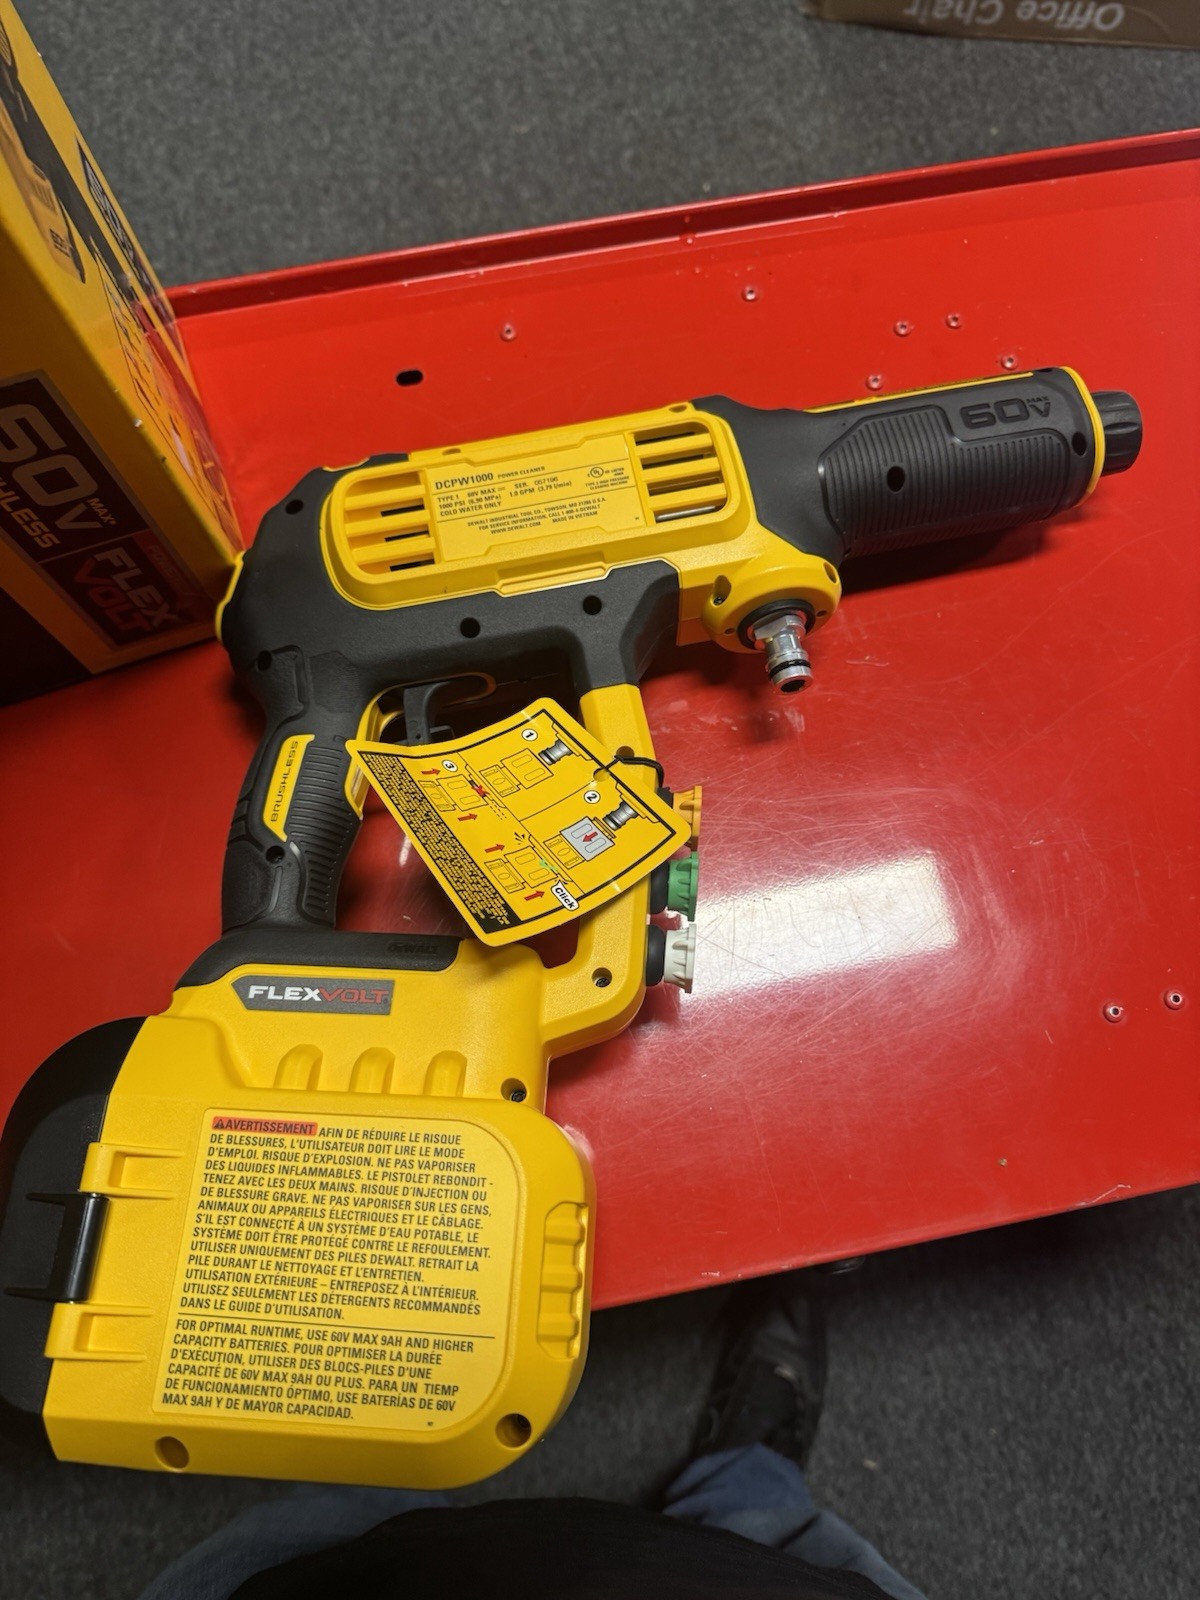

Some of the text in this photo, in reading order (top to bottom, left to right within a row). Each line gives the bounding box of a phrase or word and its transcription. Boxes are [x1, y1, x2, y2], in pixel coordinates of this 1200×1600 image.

[903, 0, 1125, 32] Office Chair
[1027, 395, 1049, 404] MAX
[435, 466, 545, 490] DCPW1000 POWER CLEANER
[519, 487, 535, 496] GPM
[440, 501, 501, 517] COLD WATER ONLY
[490, 513, 519, 523] INDUSTRIAL
[575, 510, 598, 519] VIETNAM
[490, 521, 510, 529] SERVICE
[74, 556, 154, 631] VOLT
[94, 547, 179, 629] FLEX
[270, 740, 298, 822] BRUSHLESS
[587, 793, 598, 802] 2
[555, 887, 576, 908] Click
[248, 984, 390, 1004] FLEXVOLT
[210, 1133, 464, 1158] DE BLESSURES, L'UTILISATEUR DOIT LIRE LE MODE
[222, 1119, 461, 1145] AVERTISSEMENT AFIN DE RÉDUIRE LE RISQUE
[207, 1146, 475, 1173] D'EMPLOI. RISQUE D'EXPLOSION. NE PAS VAPORISER
[205, 1160, 487, 1187] DES LIQUIDES INFLAMMABLES. LE PISTOLET REBONDIT
[197, 1200, 483, 1229] ANIMAUX OU APPAREILS ÉLECTRIQUES ET LE CÂBLAGE.
[193, 1223, 490, 1258] SYSTÈME DOIT ÊTRE PROTÉGÉ CONTRE LE REFOULEMENT.
[188, 1254, 424, 1282] PILE DURANT LE NETTOYAGE ET L'ENTRETIEN.
[190, 1240, 479, 1271] UTILISER UNIQUEMENT DES PILES DEWALT. RETRAIT LA
[185, 1269, 478, 1300] UTILISATION EXTÉRIEURE ENTREPOSEZ À L'INTÉRIEUR.
[183, 1282, 480, 1315] UTILISEZ SEULEMENT LES DÉTERGENTS RECOMMANDÉS
[173, 1333, 442, 1365] CAPACITY BATTERIES. POUR OPTIMISER LA DURÉE
[176, 1319, 474, 1352] FOR OPTIMAL RUNTIME, USE 60V MAX 9AH AND HIGHER
[171, 1347, 432, 1379] D'EXÉCUTION, UTILISER DES BLOCS-PILES D'UNE
[162, 1393, 353, 1419] MAX 9AH Y DE MAYOR CAPACIDAD.
[165, 1378, 456, 1411] DE FUNCIONAMIENTO ÓPTIMO, USE BATERÍAS DE 60V
